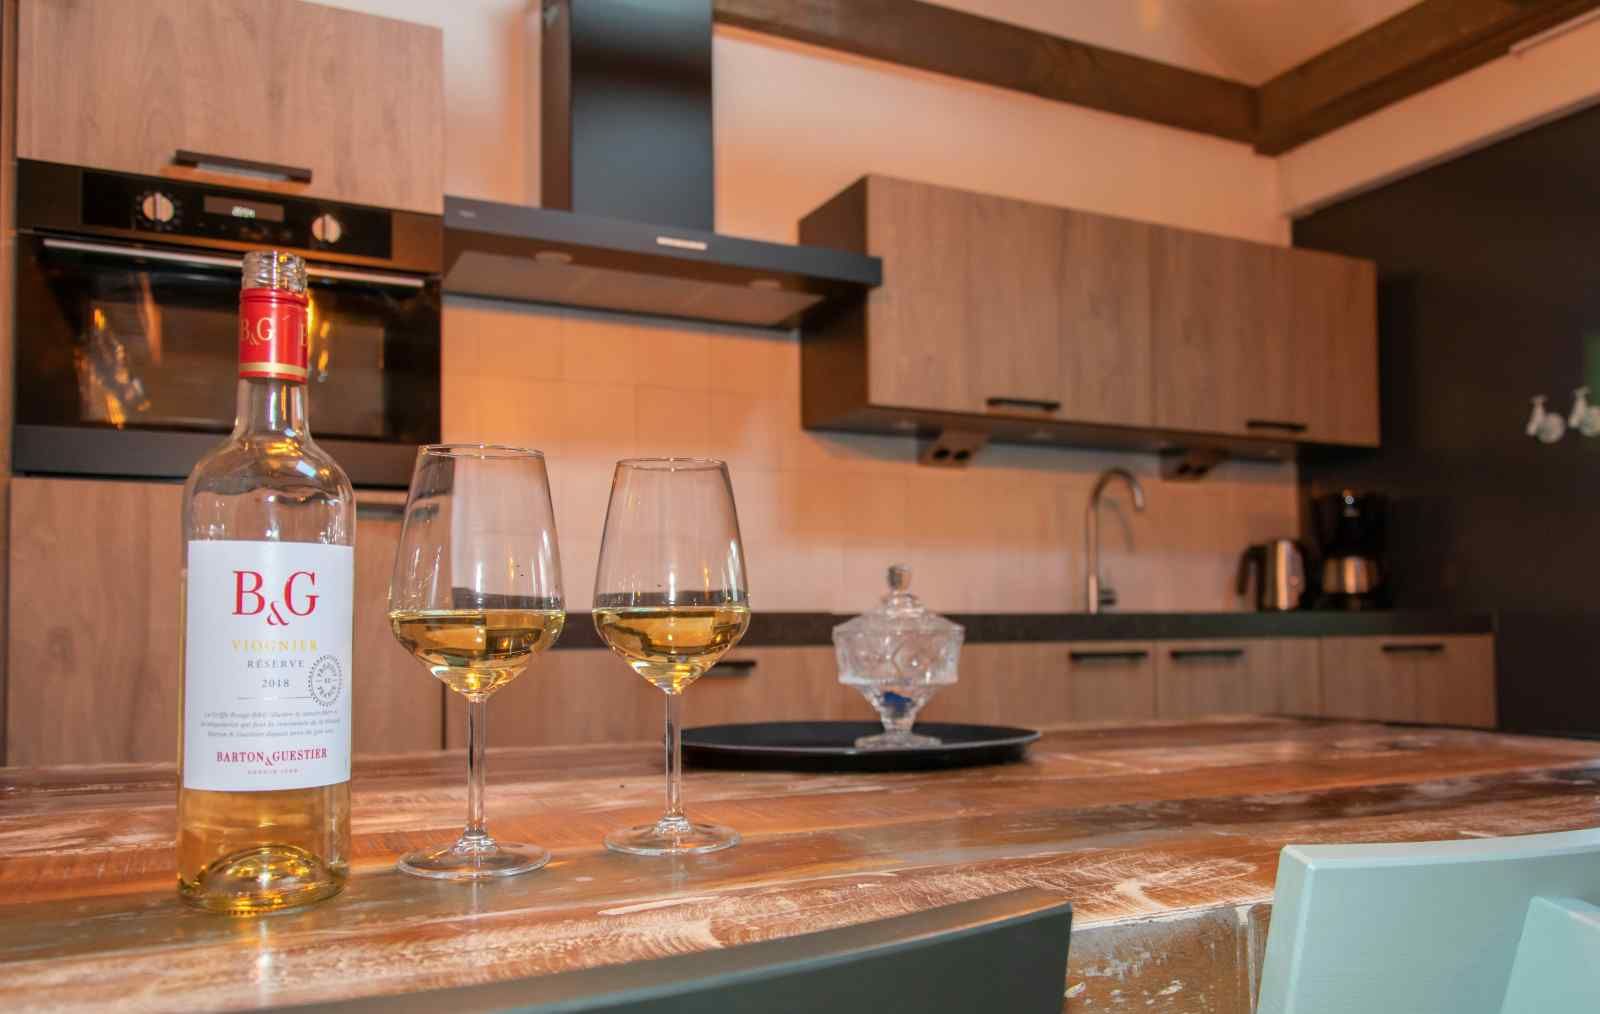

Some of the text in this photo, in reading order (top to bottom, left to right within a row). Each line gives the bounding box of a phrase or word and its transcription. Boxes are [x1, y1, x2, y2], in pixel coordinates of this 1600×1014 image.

[232, 570, 320, 626] B&G
[231, 639, 318, 653] VIOGNIER
[247, 658, 305, 669] RÉSERVE
[261, 678, 290, 689] 2018
